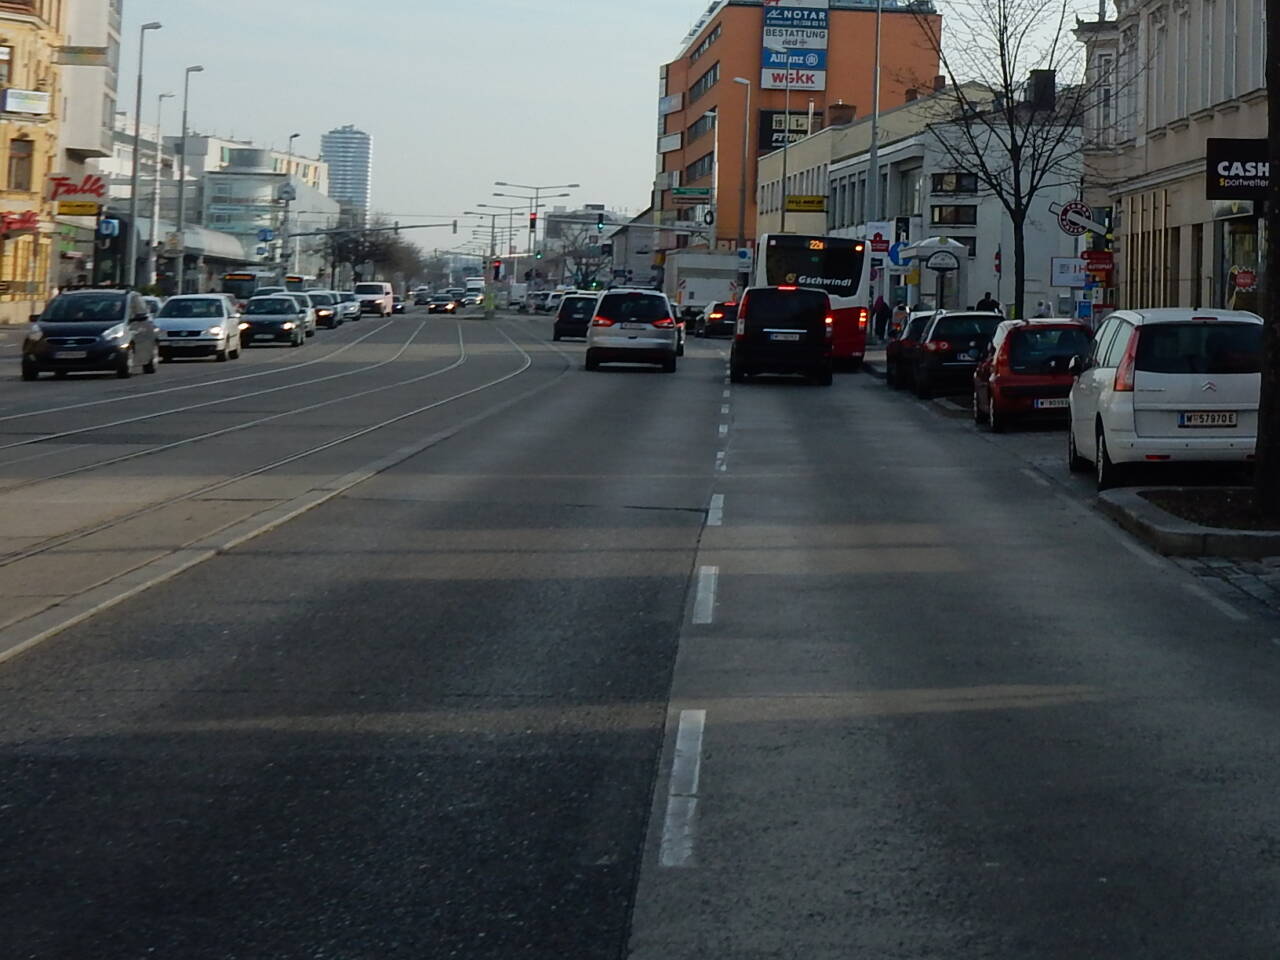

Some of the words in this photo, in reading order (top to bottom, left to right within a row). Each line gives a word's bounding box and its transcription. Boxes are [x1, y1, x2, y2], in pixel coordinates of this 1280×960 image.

[783, 10, 826, 20] NOTAR
[765, 29, 826, 39] BESTATTUNG
[769, 52, 804, 64] Allianz
[772, 70, 816, 85] WGKK
[798, 275, 852, 287] Gschwindl
